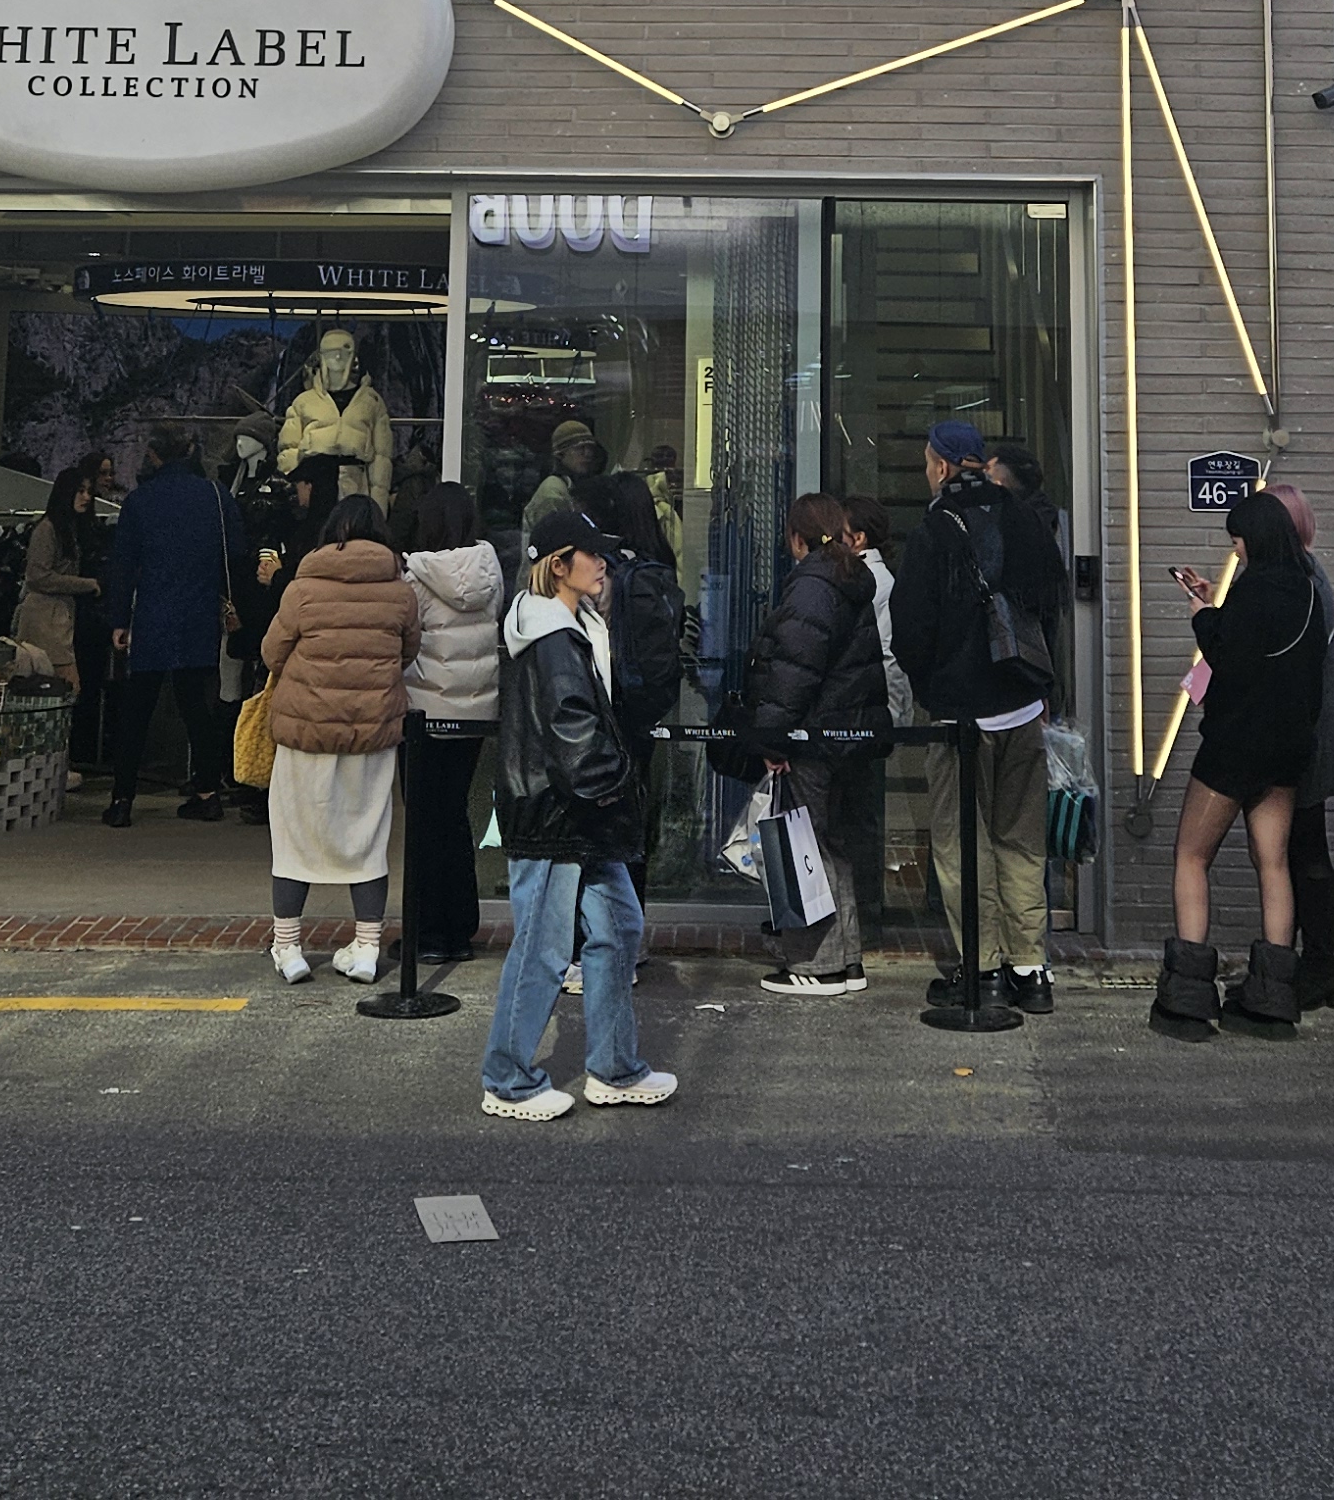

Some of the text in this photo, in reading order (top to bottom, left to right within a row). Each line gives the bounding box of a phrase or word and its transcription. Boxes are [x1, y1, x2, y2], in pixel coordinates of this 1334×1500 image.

[162, 21, 366, 68] LABEL
[27, 75, 259, 99] COLLECTION
[112, 266, 175, 283] 노스페이스
[181, 264, 266, 285] 화이트라벨
[317, 264, 409, 287] WHITE
[1198, 482, 1248, 504] 46-1
